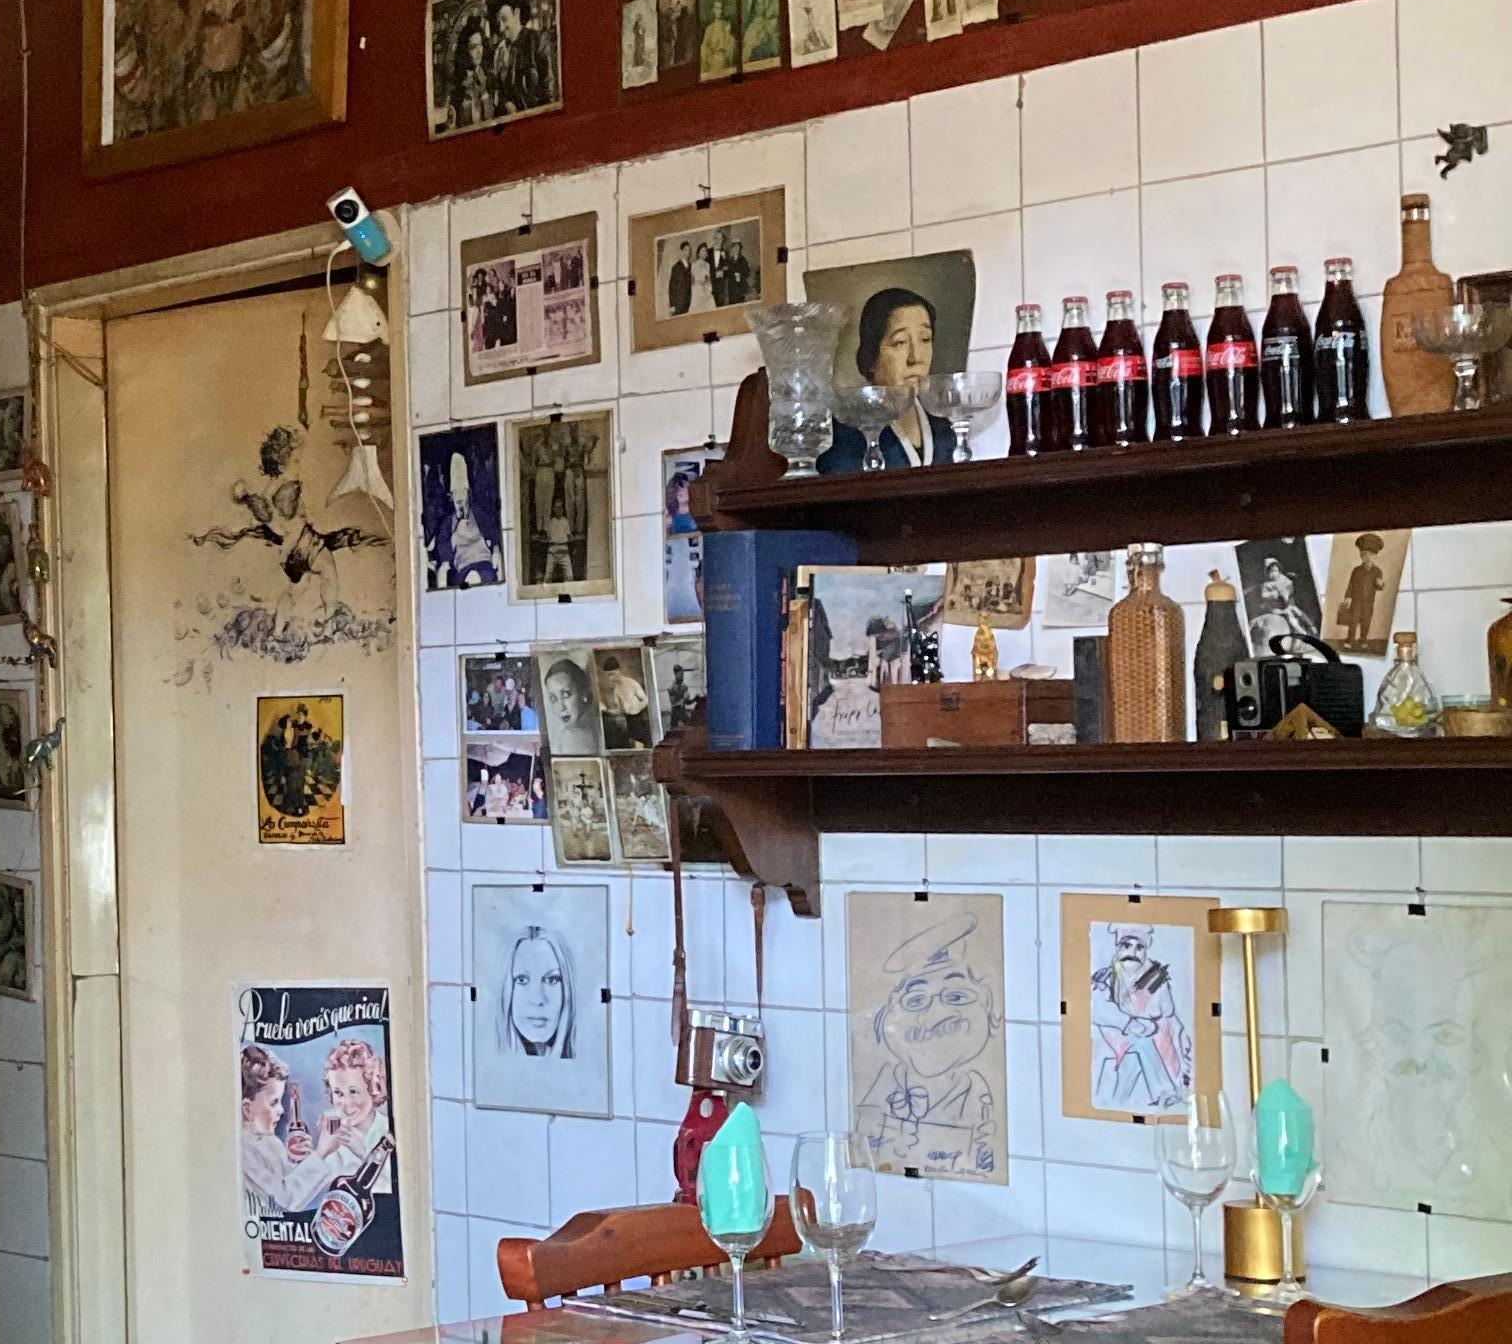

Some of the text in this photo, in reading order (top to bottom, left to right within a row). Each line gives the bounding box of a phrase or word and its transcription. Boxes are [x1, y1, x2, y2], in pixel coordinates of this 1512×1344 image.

[239, 989, 294, 1043] Prueba
[331, 1006, 353, 1037] que
[355, 990, 390, 1022] rica!
[244, 1219, 313, 1244] ORIENTAL
[349, 1258, 402, 1274] URUGUAY
